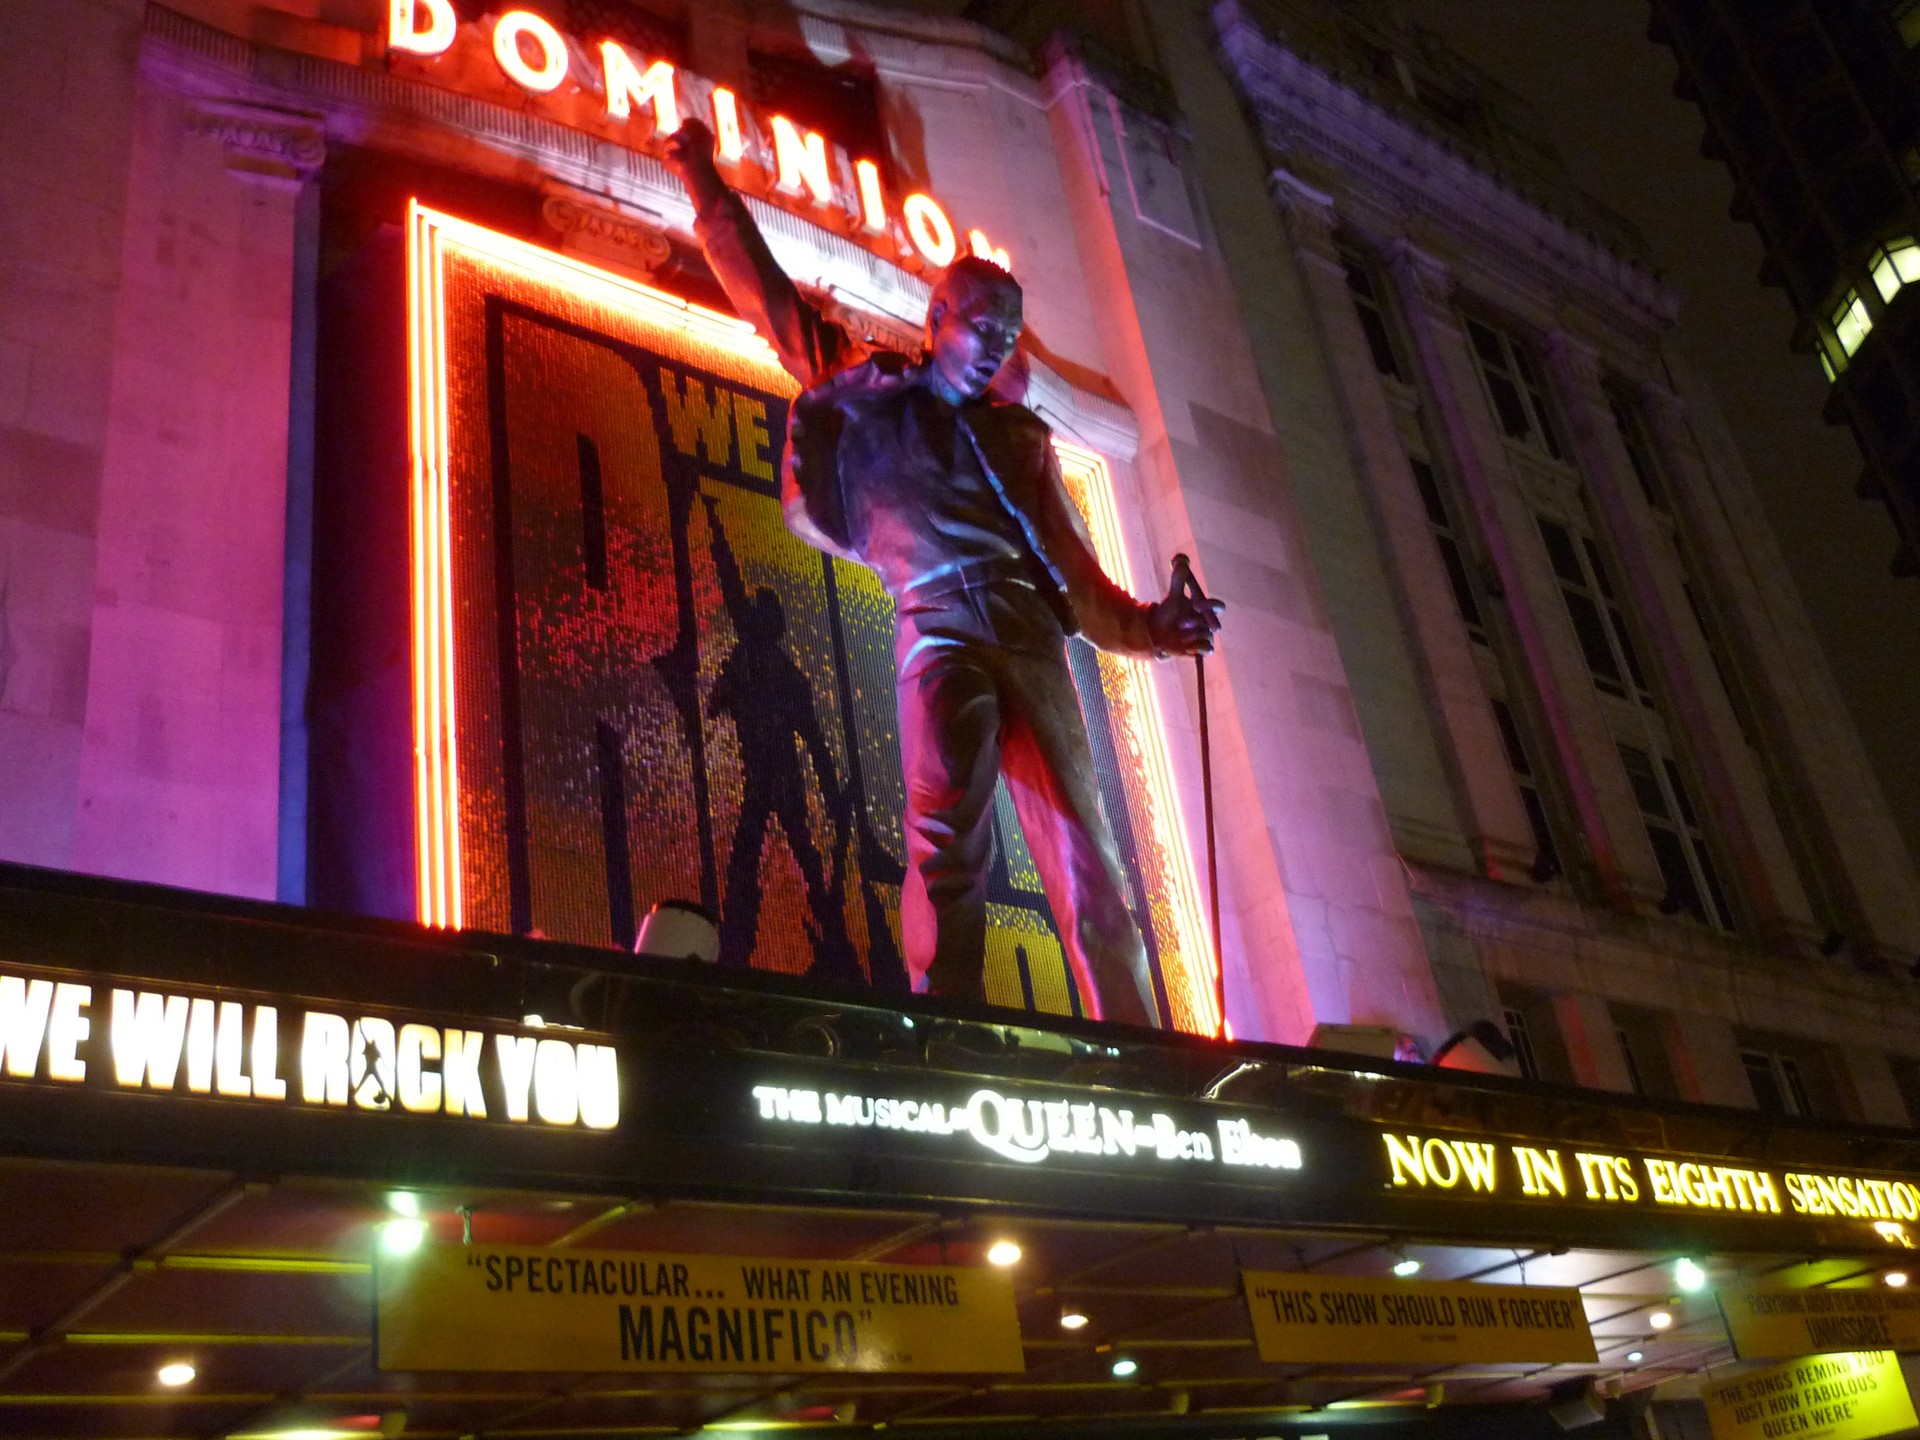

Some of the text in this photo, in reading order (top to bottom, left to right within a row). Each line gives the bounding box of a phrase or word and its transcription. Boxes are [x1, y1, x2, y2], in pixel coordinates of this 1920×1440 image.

[660, 366, 774, 482] WE
[0, 975, 619, 1129] WE WILL ROCK YOU
[753, 1085, 822, 1123] THE
[824, 1093, 953, 1134] MUSICAL
[967, 1089, 1136, 1163] QUEEN
[1382, 1133, 1494, 1193] NOW
[1512, 1146, 1566, 1197] IN
[1575, 1153, 1639, 1201] ITS
[1643, 1158, 1781, 1213] EIGHTH
[742, 1266, 810, 1300] WHAT
[822, 1270, 851, 1302] AN
[861, 1272, 958, 1306] EVENING
[1320, 1292, 1378, 1326] SHOW
[1386, 1295, 1455, 1327] SHOULD
[1461, 1297, 1497, 1328] RUN
[1735, 1374, 1877, 1424] JUST HOW FABULOUS
[1751, 1371, 1793, 1397] SONGS
[1798, 1359, 1852, 1386] REMIND
[1763, 1413, 1808, 1439] QUEEN
